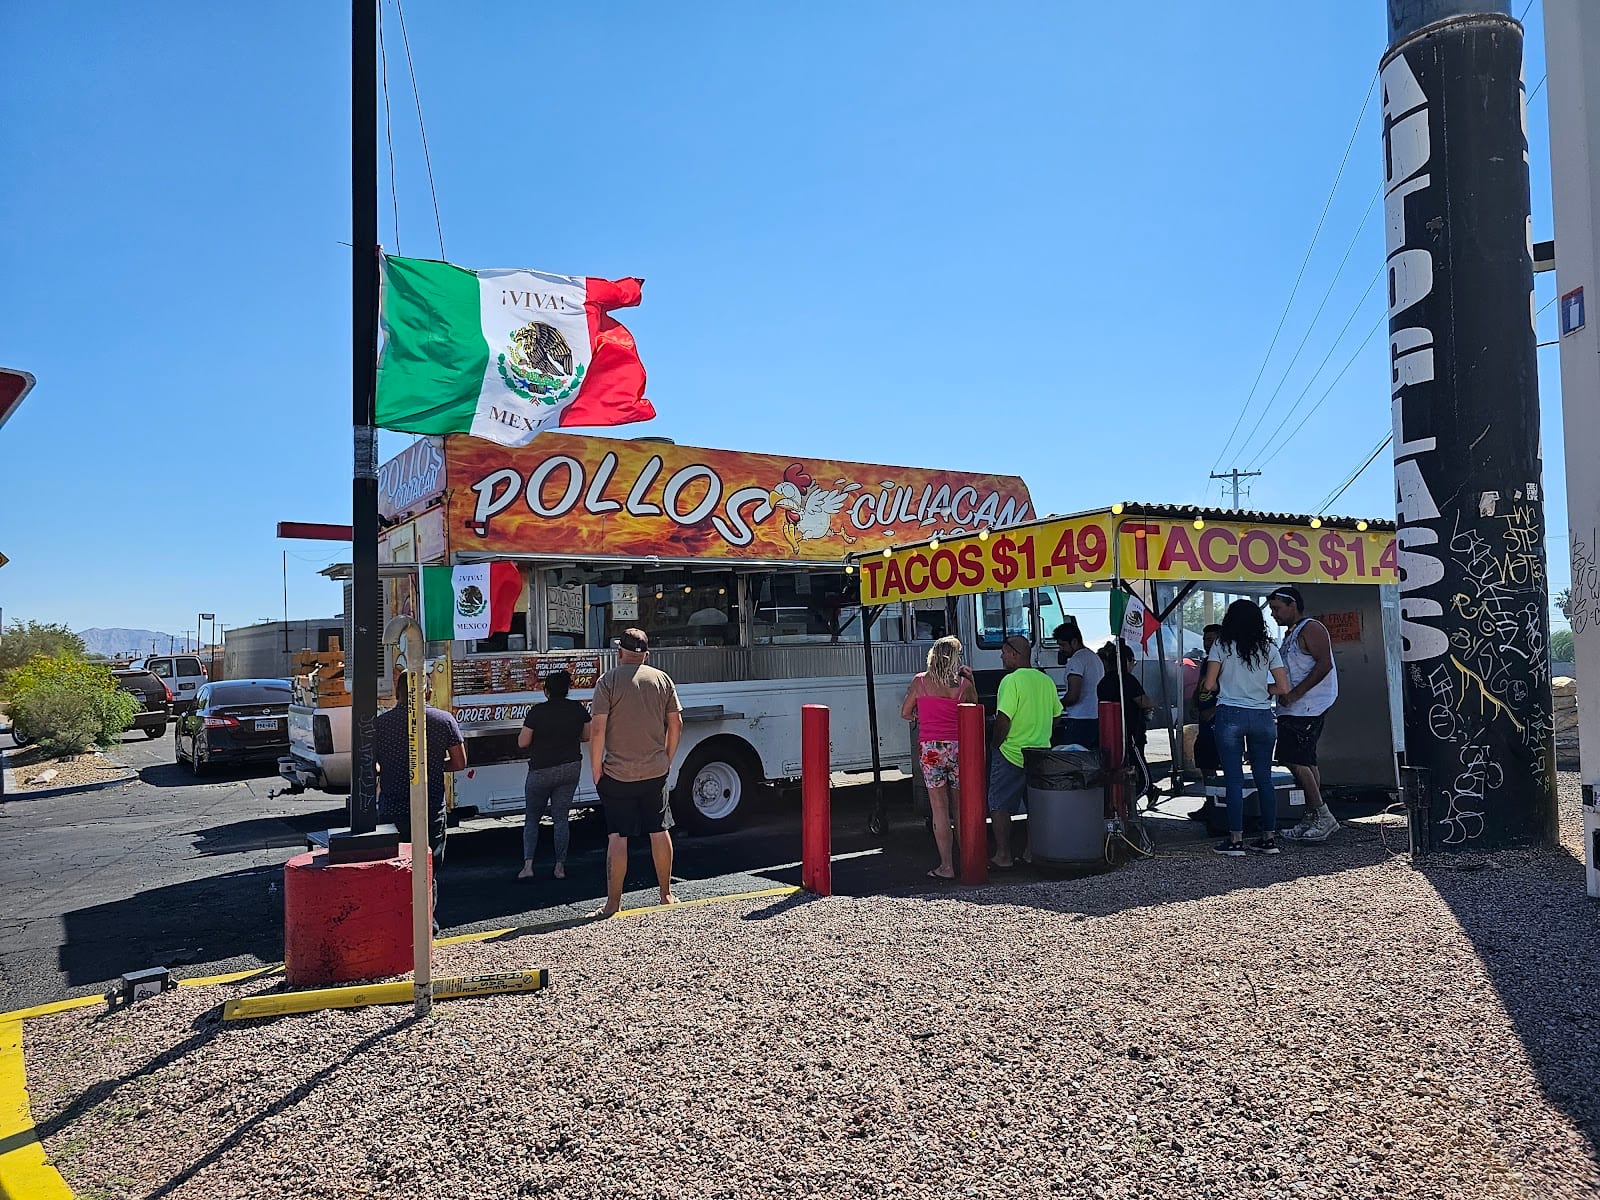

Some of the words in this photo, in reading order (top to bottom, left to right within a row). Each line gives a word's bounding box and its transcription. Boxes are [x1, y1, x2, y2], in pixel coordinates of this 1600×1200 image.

[501, 289, 566, 311] ¡VIVA!
[489, 405, 551, 432] MEXI
[472, 451, 774, 547] POLLOS
[850, 483, 1030, 531] CULIACAN
[863, 544, 985, 599] TACOS
[991, 524, 1107, 589] $1.49
[1119, 523, 1311, 575] TACOS
[1318, 529, 1397, 581] $1.4
[456, 622, 488, 630] MEXICO
[455, 706, 492, 723] ORDER
[494, 705, 508, 721] BY
[510, 704, 532, 720] PHO
[462, 983, 523, 993] PIPELINE
